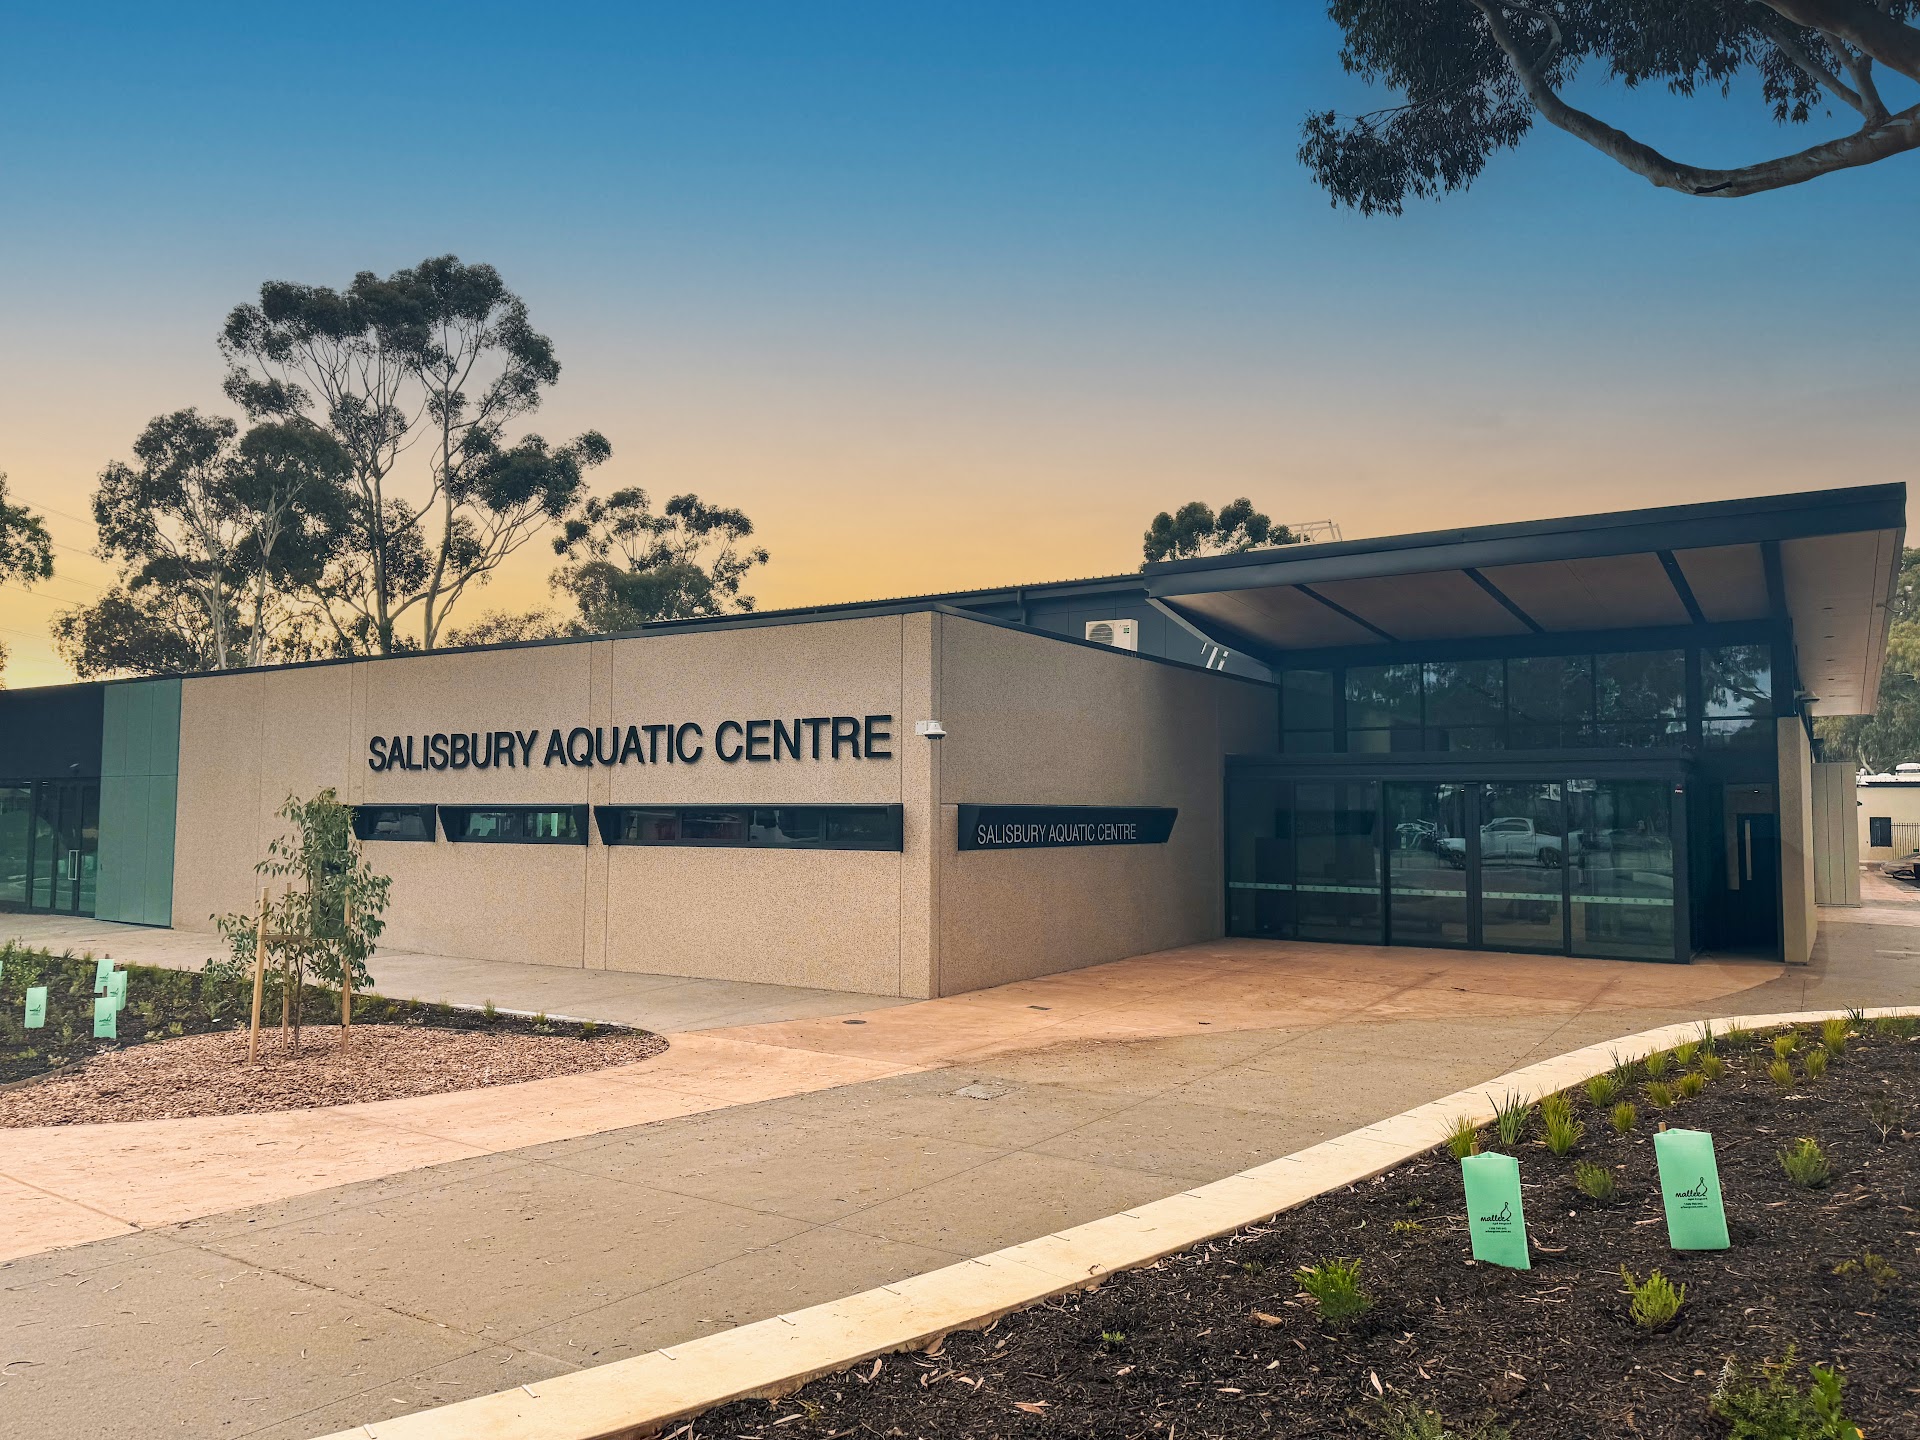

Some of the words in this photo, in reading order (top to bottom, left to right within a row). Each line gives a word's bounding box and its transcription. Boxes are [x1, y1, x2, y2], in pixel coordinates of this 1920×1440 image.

[368, 730, 538, 772] SALISBURY
[543, 722, 703, 767] AQUATIC
[714, 714, 892, 761] CENTRE
[977, 824, 1047, 844] SALISBURY
[1048, 823, 1095, 843] AQUATIC
[1097, 823, 1137, 841] CENTRE
[1675, 1189, 1704, 1198] mallee
[1480, 1214, 1508, 1222] mallee
